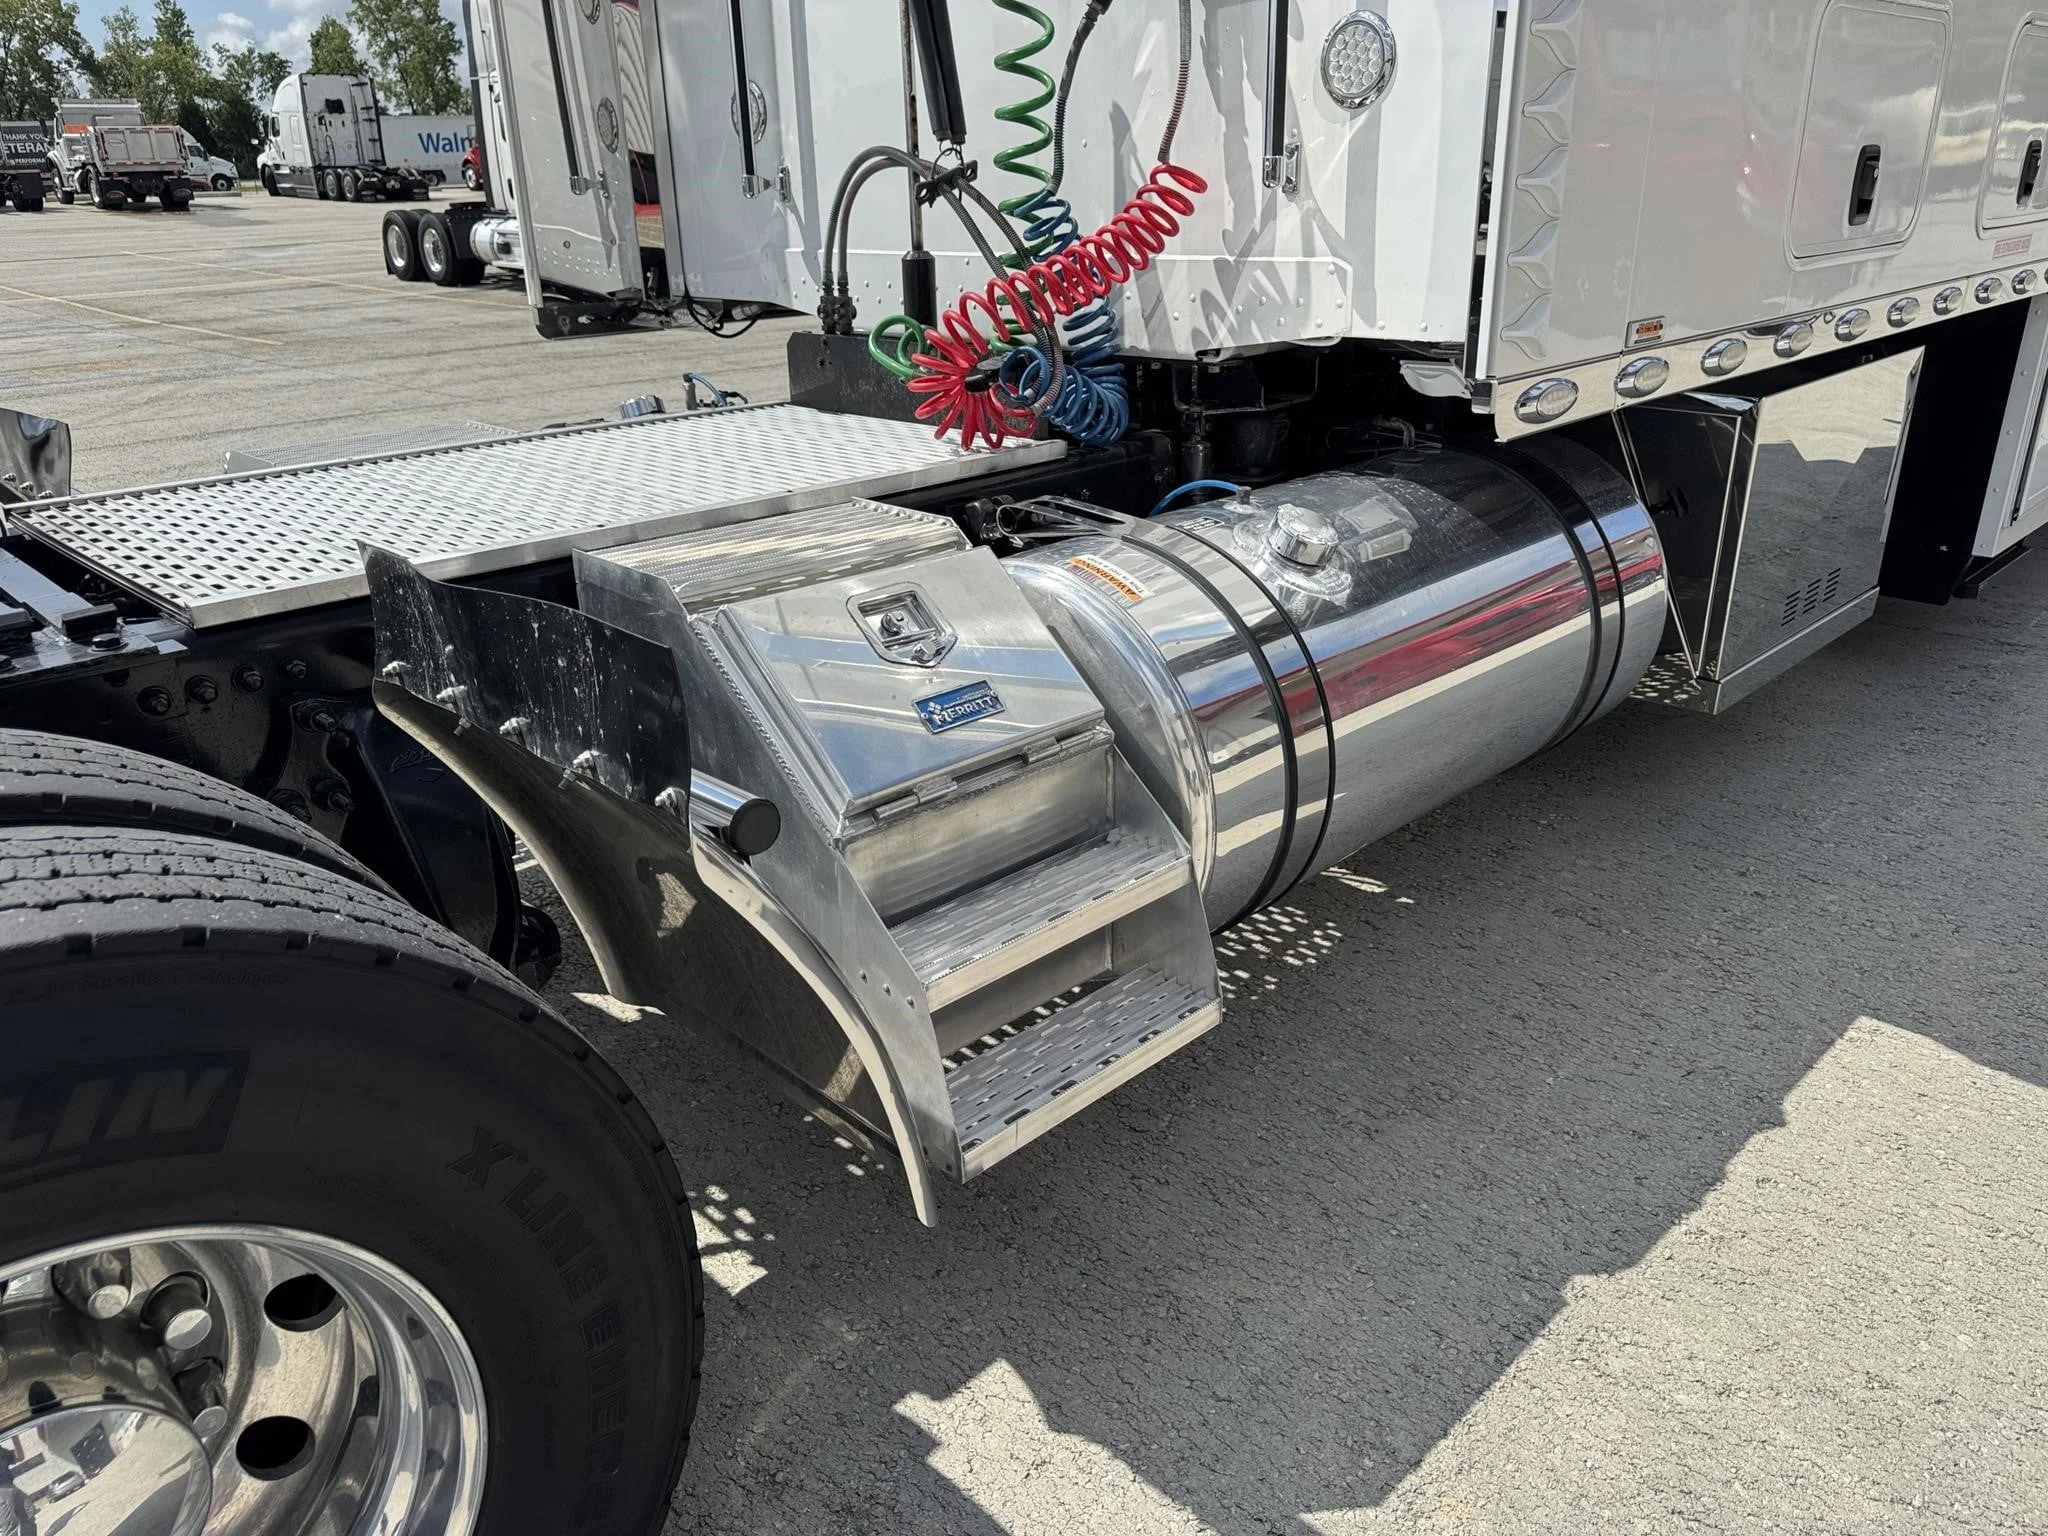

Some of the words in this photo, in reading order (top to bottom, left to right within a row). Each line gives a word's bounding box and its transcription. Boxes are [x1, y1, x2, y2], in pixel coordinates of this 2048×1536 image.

[1075, 559, 1127, 591] WARNING
[933, 697, 993, 725] MERRITT
[500, 1166, 611, 1304] LINE
